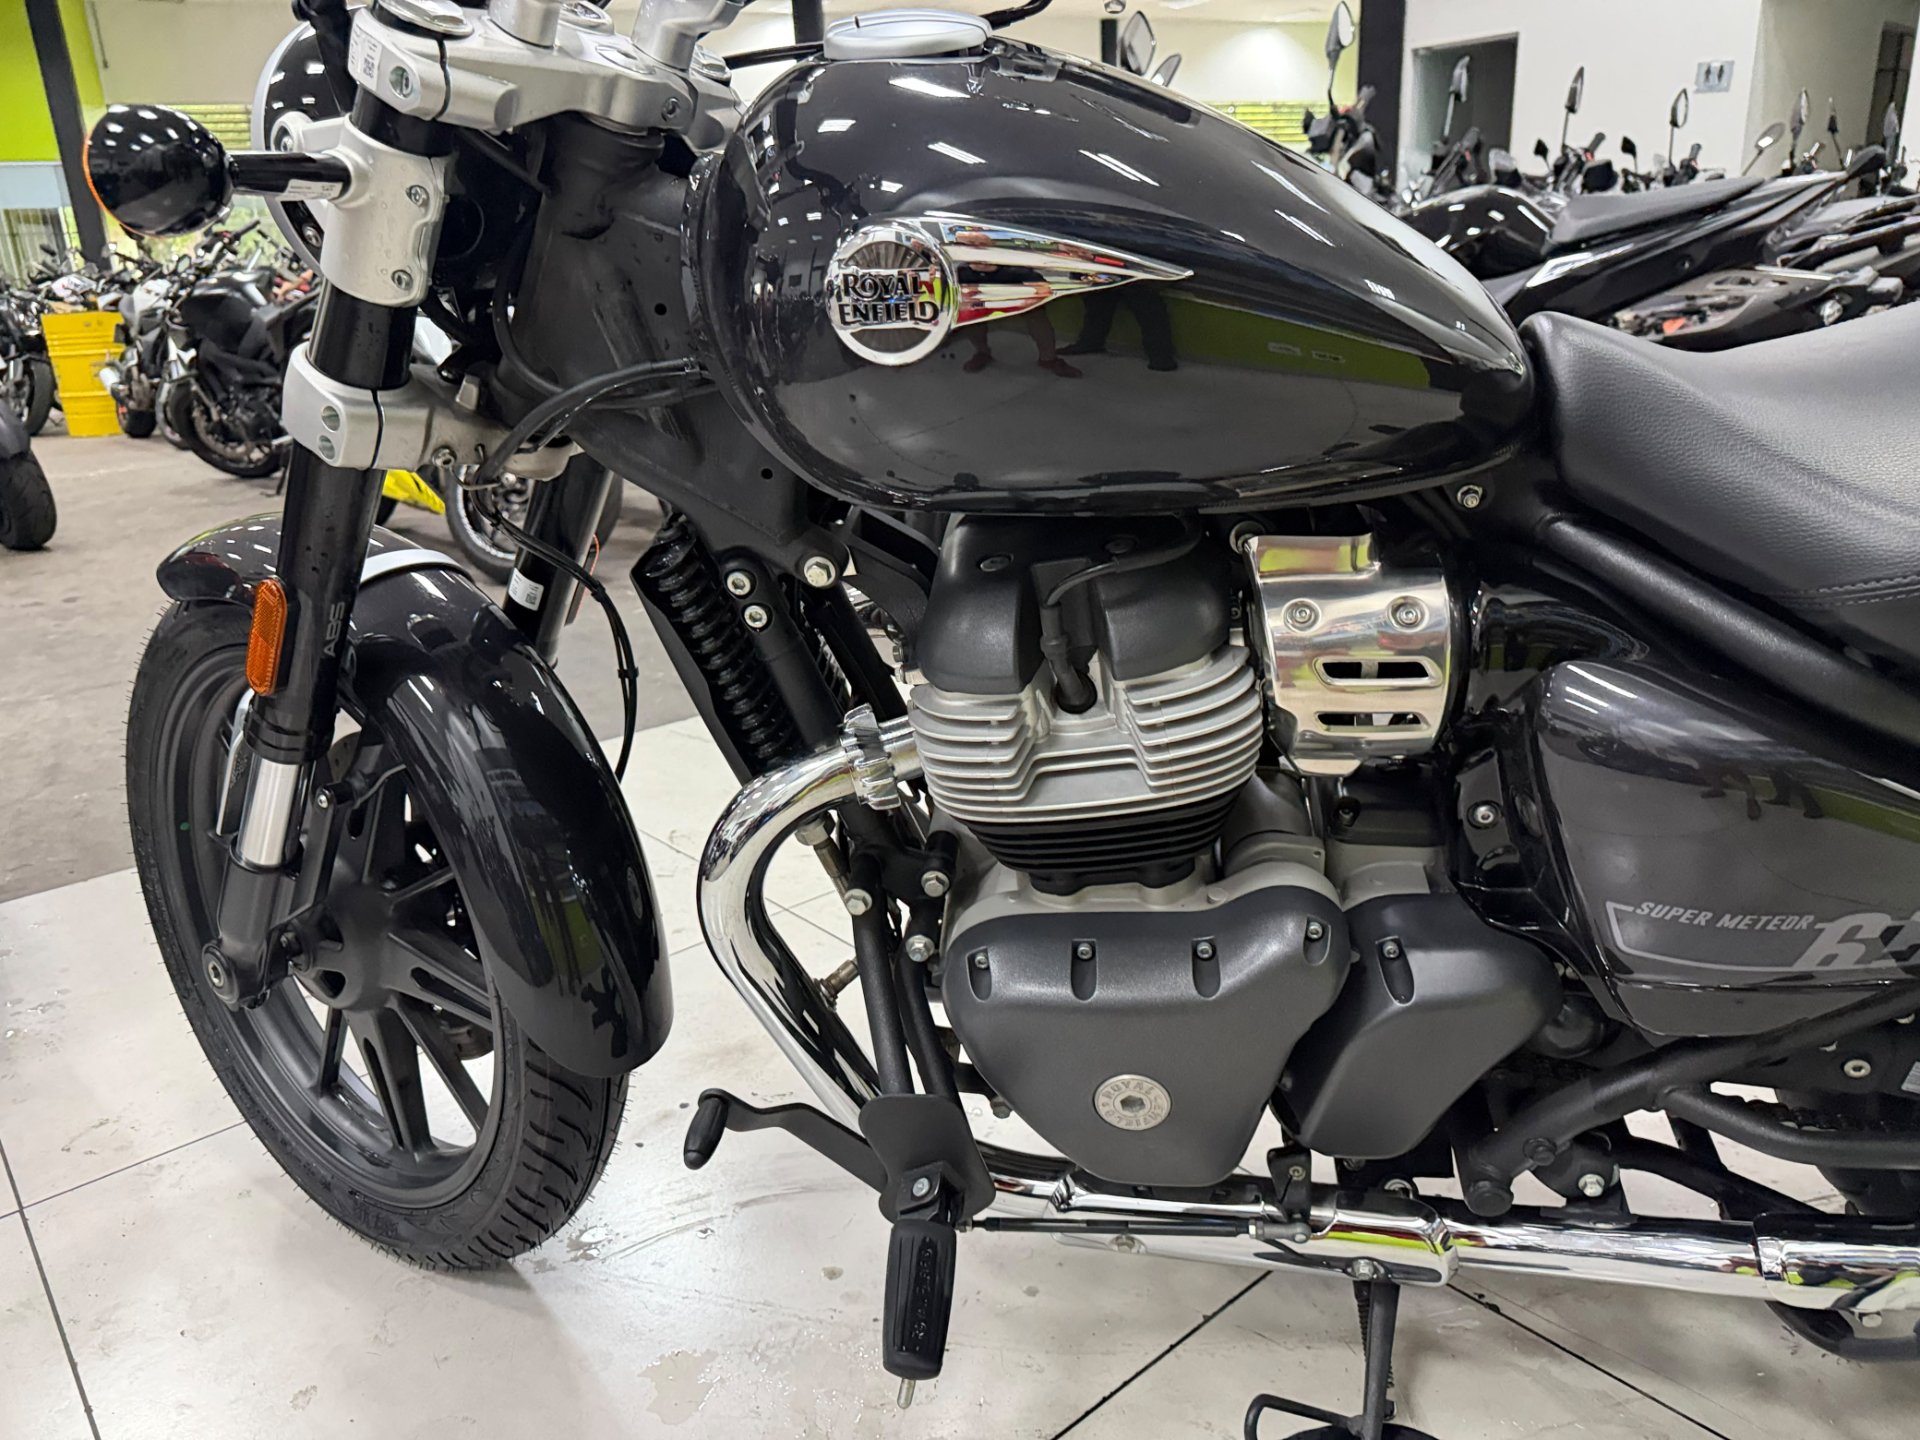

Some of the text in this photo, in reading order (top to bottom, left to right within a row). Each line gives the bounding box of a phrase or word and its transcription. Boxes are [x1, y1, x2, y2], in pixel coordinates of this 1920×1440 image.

[841, 269, 928, 300] ROYAL
[838, 301, 940, 325] ENFIELD
[323, 601, 346, 657] ABS
[1635, 902, 1713, 926] SUPER
[1715, 913, 1815, 930] METEOR
